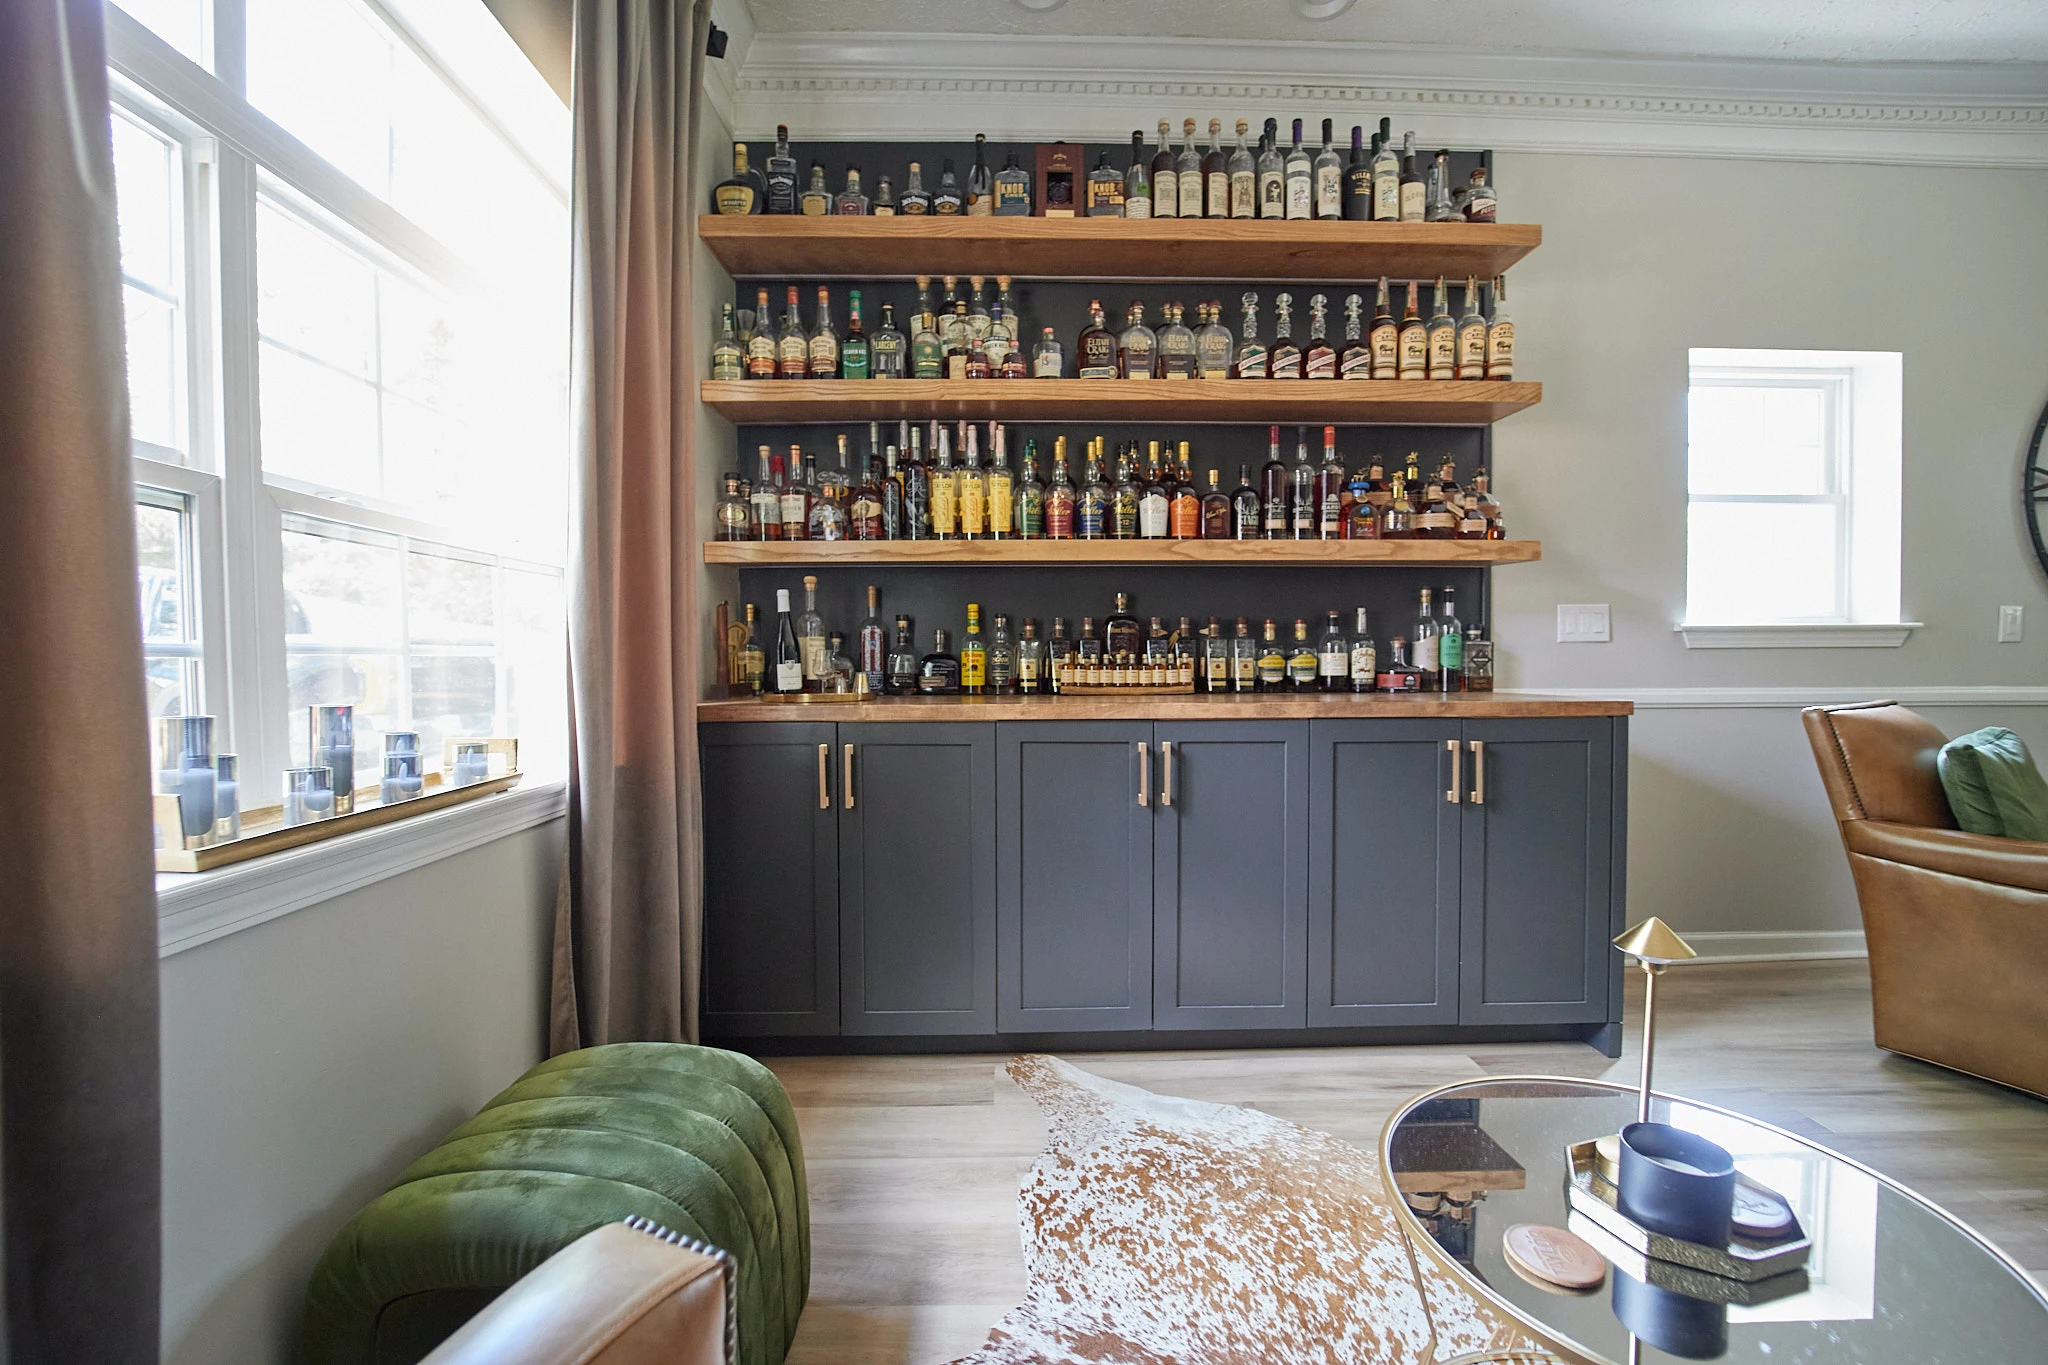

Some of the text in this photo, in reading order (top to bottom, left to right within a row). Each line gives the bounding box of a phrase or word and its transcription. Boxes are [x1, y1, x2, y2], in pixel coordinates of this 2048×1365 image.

[1001, 183, 1024, 195] KNOB
[1095, 183, 1116, 194] KNOB
[876, 341, 896, 349] LARCENY
